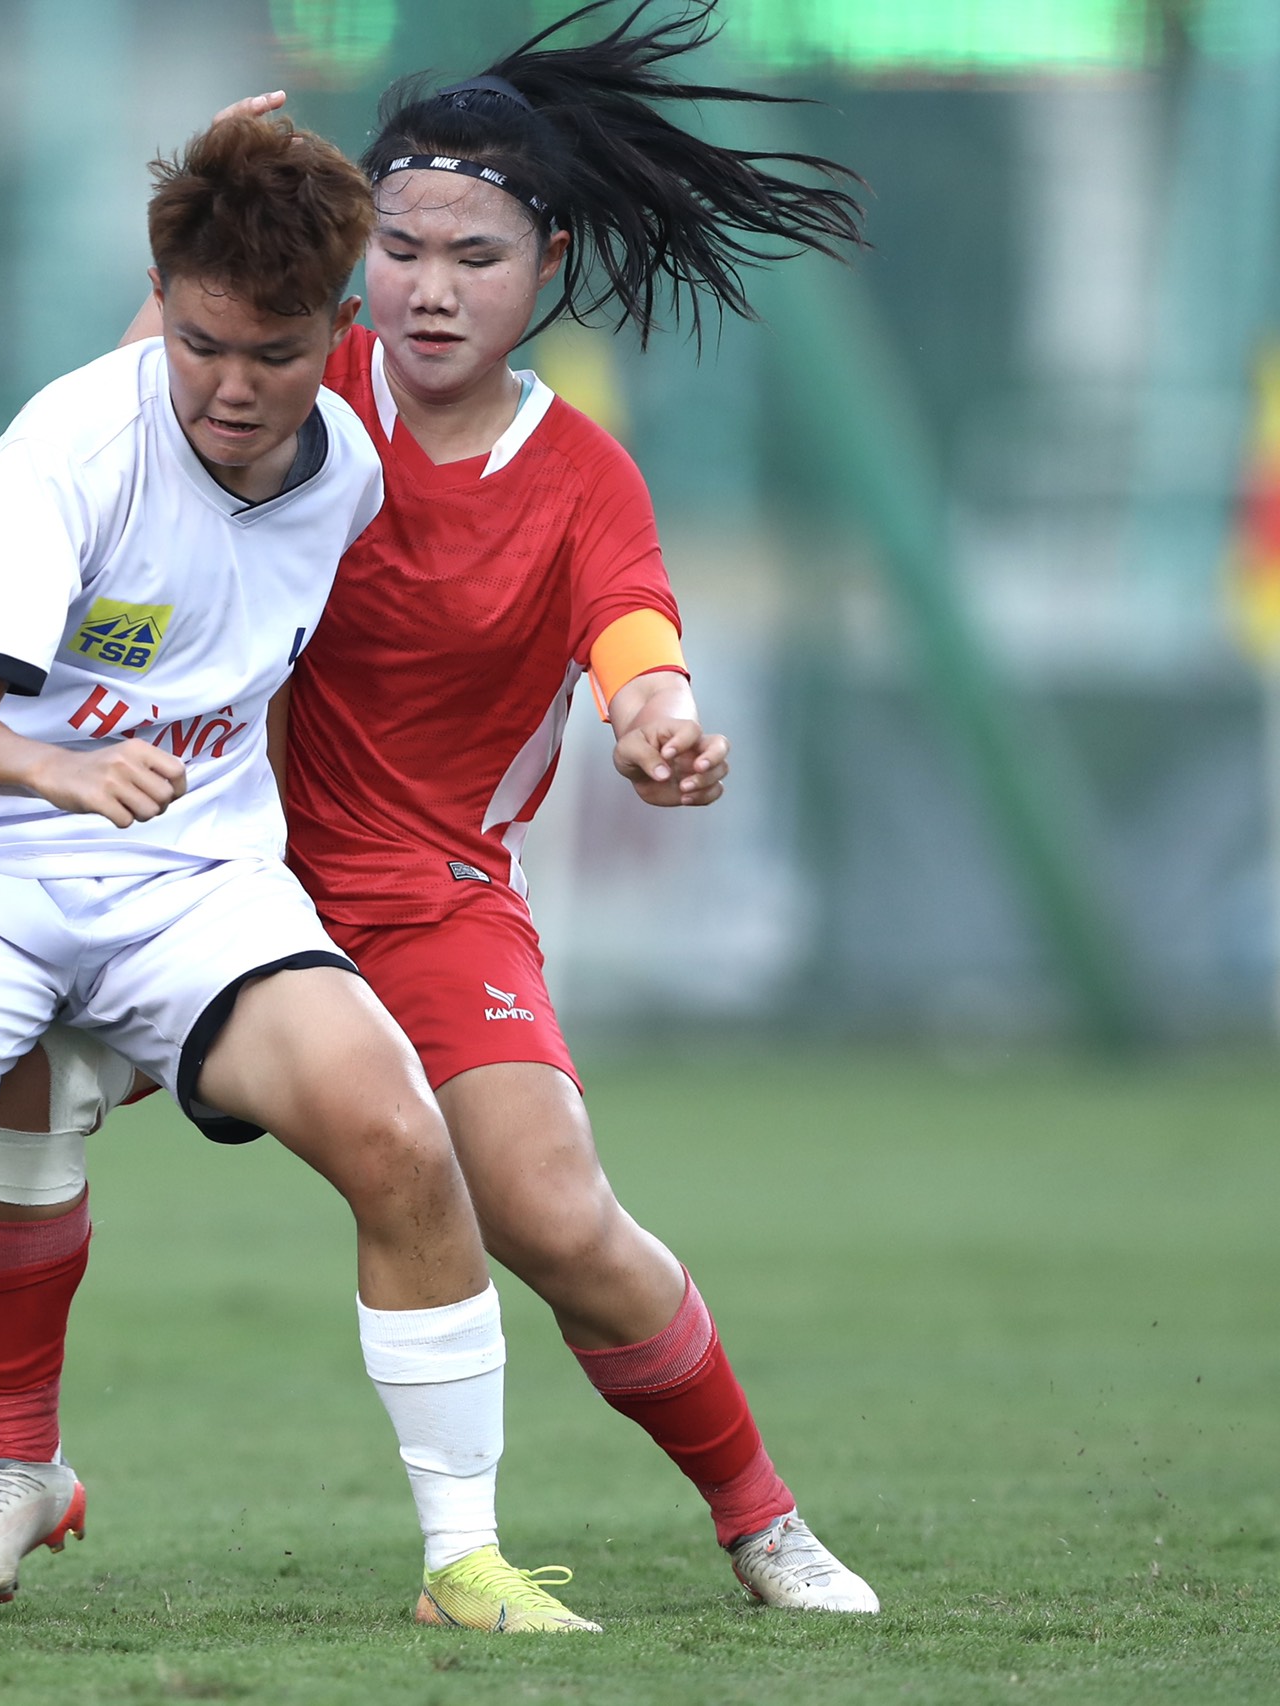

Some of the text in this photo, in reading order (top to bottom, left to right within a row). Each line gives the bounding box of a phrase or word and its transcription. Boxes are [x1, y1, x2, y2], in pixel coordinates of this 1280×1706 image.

[388, 156, 413, 172] NIKE
[430, 156, 461, 170] NIKE
[480, 167, 507, 186] NIKE
[79, 632, 151, 668] TSB
[484, 1007, 535, 1022] KAMITO
